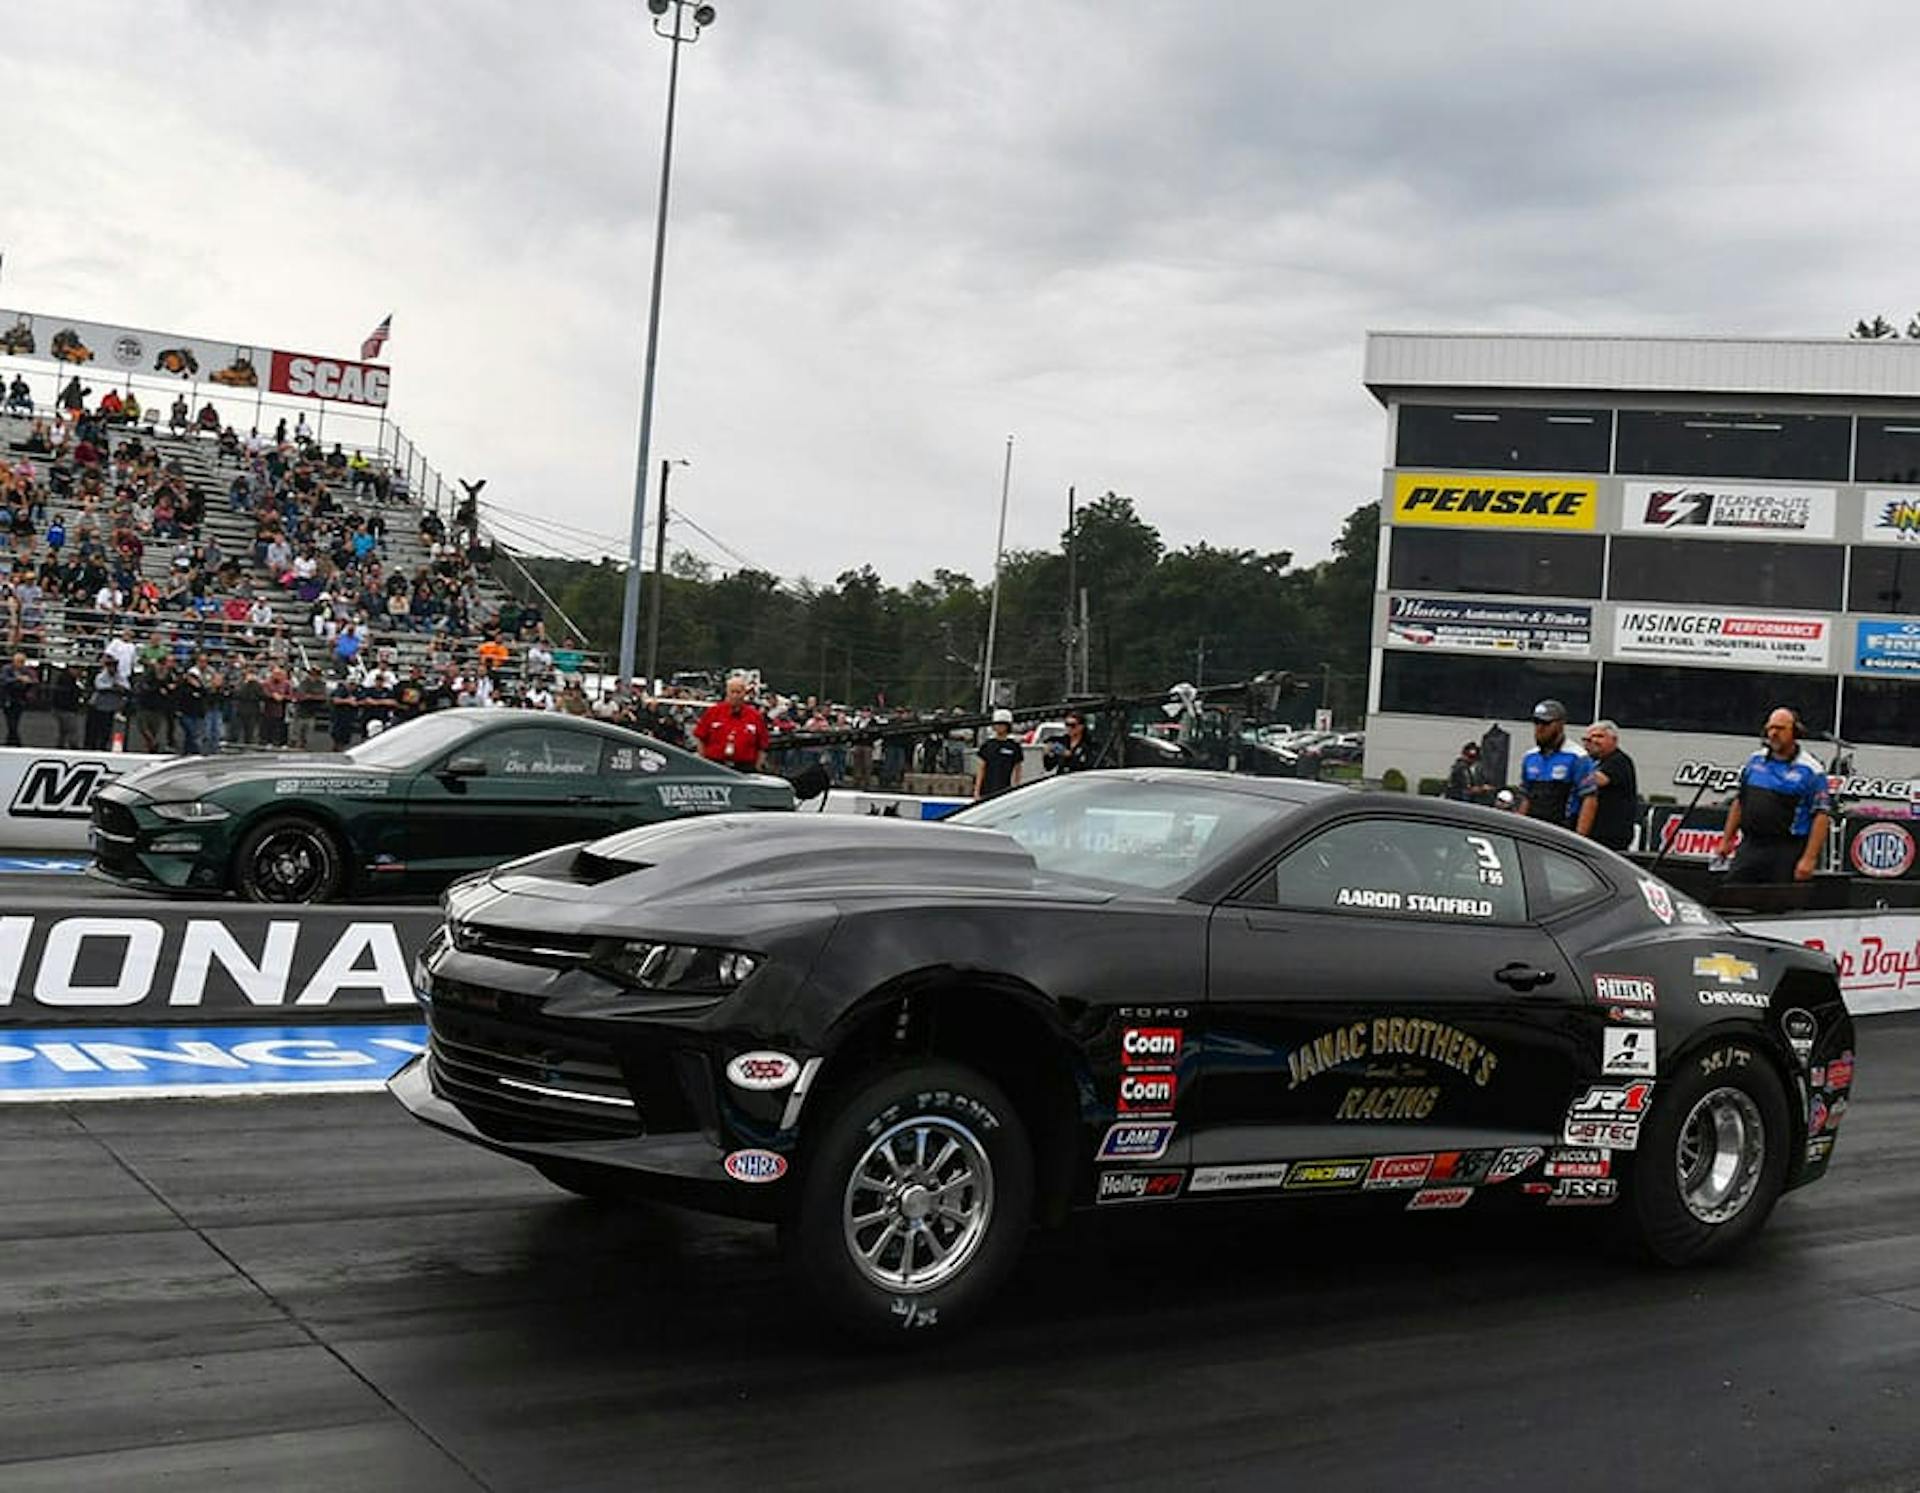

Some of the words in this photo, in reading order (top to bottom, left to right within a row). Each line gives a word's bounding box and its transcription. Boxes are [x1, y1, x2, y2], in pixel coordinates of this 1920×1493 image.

[289, 358, 389, 406] SCAG
[1402, 487, 1587, 515] PENSKE
[1714, 507, 1809, 522] BATTERIES
[1397, 598, 1459, 619] Winters
[1622, 614, 1721, 634] INSINGER
[1638, 635, 1668, 646] RACE
[1669, 637, 1695, 647] FUEL
[1704, 639, 1767, 651] INDUSTRIAL
[1677, 763, 1743, 790] Map
[10, 761, 104, 817] M
[656, 786, 732, 804] VARSITY
[1466, 836, 1501, 869] 3
[1861, 832, 1906, 867] NHRA
[1337, 888, 1400, 909] AARON
[1406, 894, 1492, 916] STANFIELD
[1700, 990, 1770, 1008] CHEVROLET
[1119, 1007, 1189, 1018] COPO
[1123, 1030, 1175, 1053] Coan
[1373, 1017, 1498, 1086] BROTHER'S
[1120, 1078, 1169, 1100] Coan
[1336, 1086, 1440, 1120] RACING
[1116, 1129, 1159, 1146] LAMB
[733, 1158, 780, 1177] NHRA
[1101, 1174, 1148, 1196] Holley
